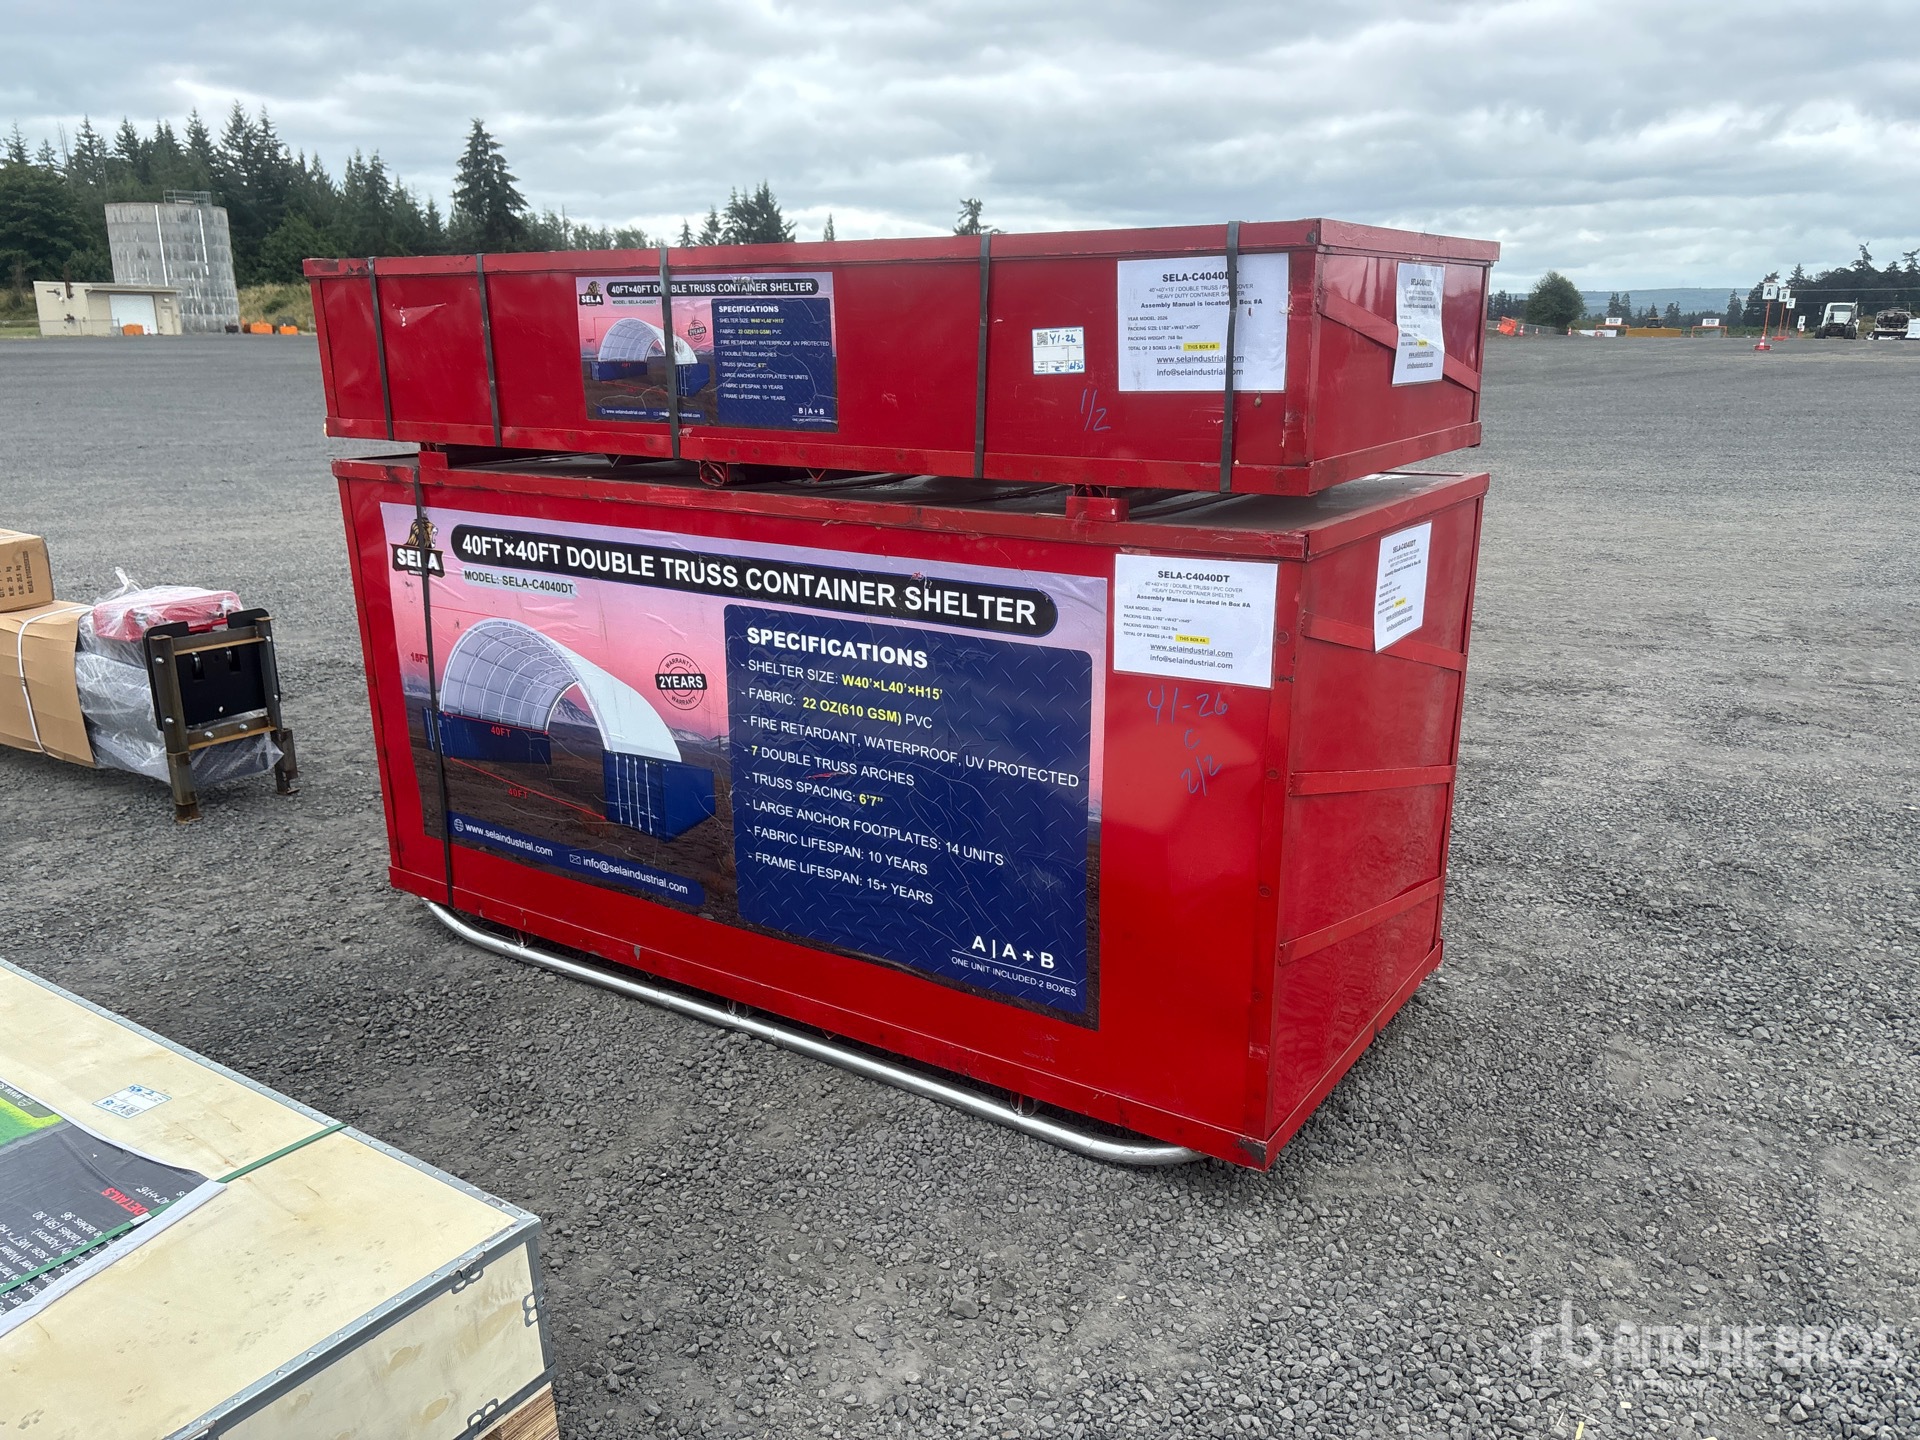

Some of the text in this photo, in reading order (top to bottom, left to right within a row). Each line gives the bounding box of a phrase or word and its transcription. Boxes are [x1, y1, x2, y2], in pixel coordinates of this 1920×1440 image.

[653, 284, 688, 293] DBLE
[689, 283, 717, 293] TRUSS
[717, 282, 768, 293] CONTAINER
[770, 282, 813, 292] SHELTER
[1766, 288, 1772, 297] A
[580, 295, 602, 303] SELA
[718, 305, 779, 313] SPECIFICATIONS
[1156, 354, 1244, 364] www.selaindustrialom
[1156, 368, 1244, 377] info@selaindustrialom
[464, 570, 574, 595] MODEL: SELA-C4040DT
[566, 546, 655, 578] DOUBLE
[660, 556, 738, 589] TRUSS
[745, 566, 897, 608] CONTAINER
[904, 586, 1037, 626] SHELTER
[1157, 570, 1230, 583] SELA-C4040DT
[1137, 594, 1165, 602] Assembly
[1182, 590, 1211, 598] CONTAINER
[747, 627, 928, 669] SPECIFICATIONS
[1150, 643, 1234, 658] www.selaindustrial.com
[664, 657, 693, 669] WARRANTY
[1150, 654, 1233, 669] info@selaindustrial.com
[659, 675, 704, 688] 2YEARS
[748, 659, 804, 679] SHELTER
[807, 669, 838, 685] SIZE:
[671, 695, 697, 706] WARRANTY
[748, 687, 796, 706] FABRIC:
[802, 696, 817, 710] 22
[867, 707, 902, 726] GSM)
[905, 713, 933, 729] PVC
[490, 725, 511, 738] 40FT
[750, 715, 1079, 787] FIRE RETARDANT, WATERPROOF, UV PROTECTED
[751, 745, 915, 786] 7 DOUBLE TRUSS ARCHES
[508, 787, 528, 800] 40FT
[752, 772, 793, 790] TRUSS
[796, 781, 856, 803] SPACING:
[465, 823, 553, 858] www.selaindustrial.com
[753, 800, 1004, 866] LARGE ANCHOR FOOTPLATES: 14 UNITS
[754, 826, 928, 875] FABRIC LIFESPAN: 10 YEARS
[583, 855, 689, 895] info@selaindustrial.com
[755, 852, 934, 904] FRAME LIFESPAN: 15+ YEARS
[971, 935, 986, 953] A
[1002, 943, 1017, 960] A
[1040, 951, 1055, 969] B
[951, 956, 1077, 997] ONE UNIT INCLUDED 2 BOXES
[101, 1187, 149, 1216] DETAILS
